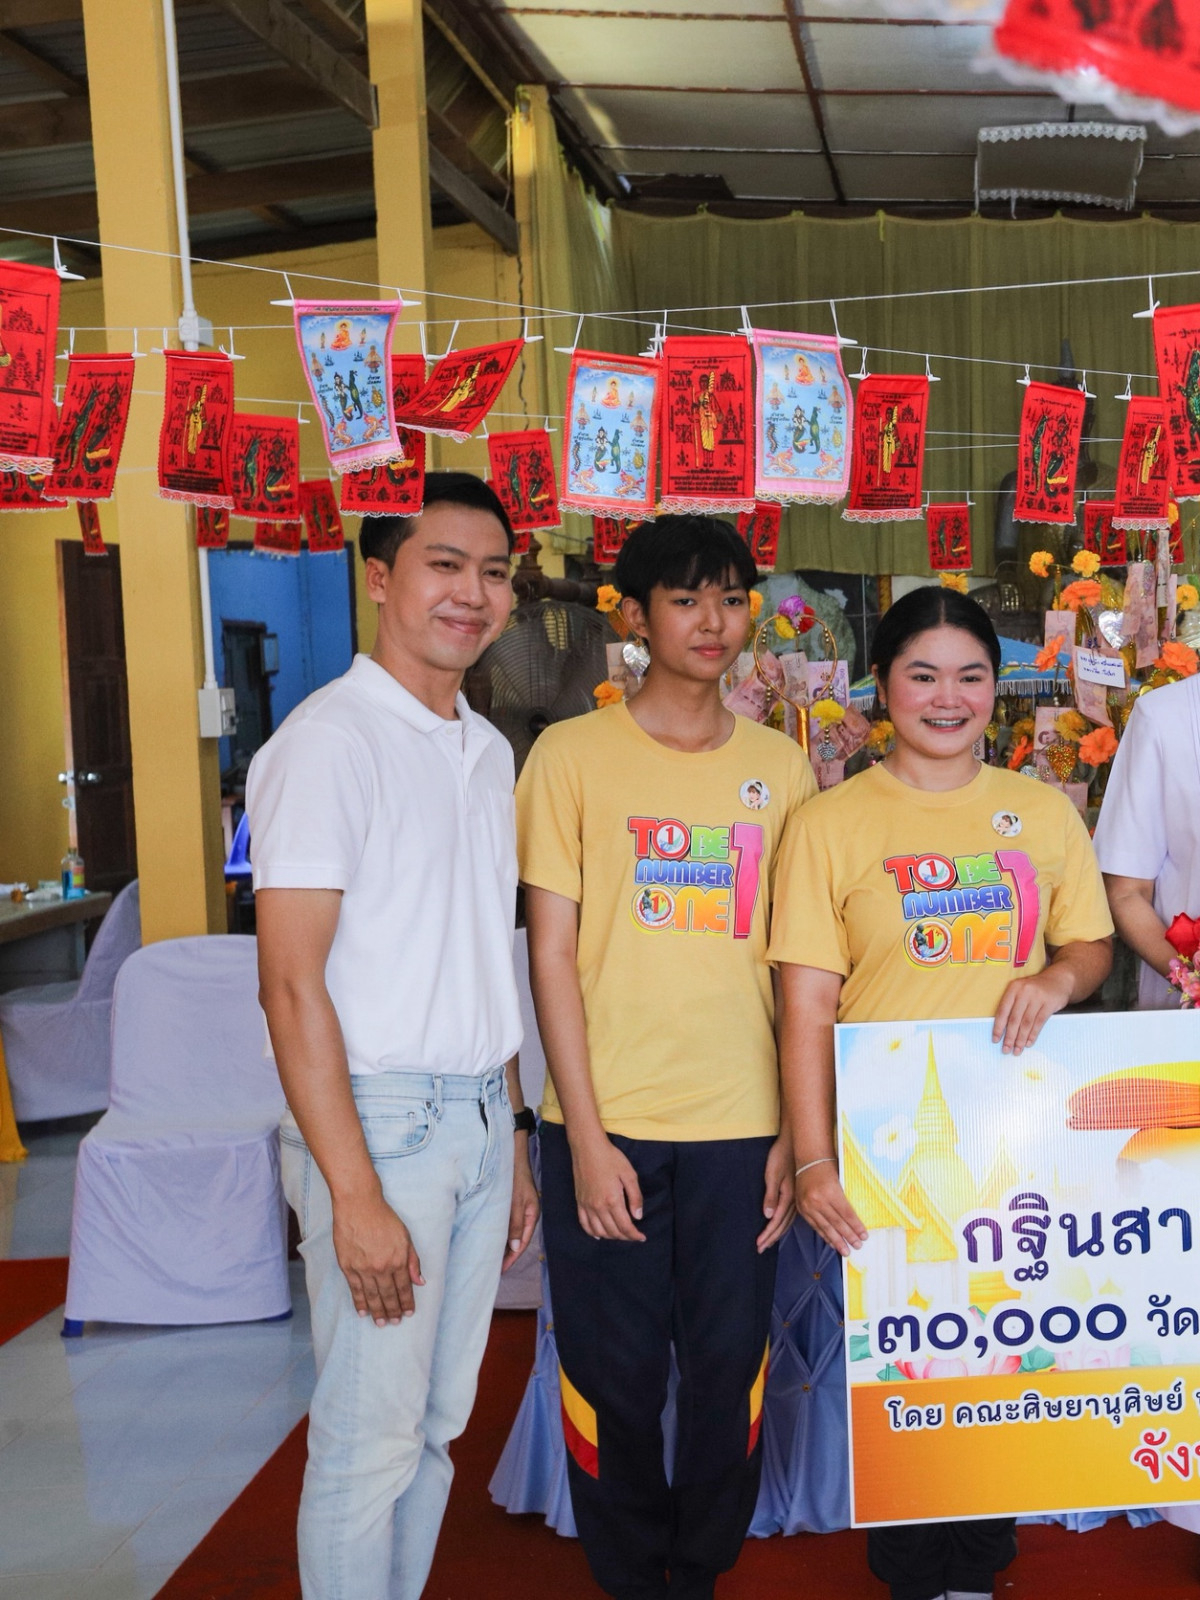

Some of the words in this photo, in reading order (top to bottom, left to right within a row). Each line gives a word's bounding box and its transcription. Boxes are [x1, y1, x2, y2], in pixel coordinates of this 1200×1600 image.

[628, 816, 690, 860] TO
[690, 825, 730, 859] BE
[636, 858, 734, 887] NUMBER
[884, 853, 957, 894] TO
[953, 853, 1002, 886] BE
[631, 884, 731, 933] ONE
[902, 884, 1014, 919] NUMBER
[904, 911, 1012, 967] ONE
[877, 1302, 1128, 1360] ๓๐,๐๐๐
[1146, 1294, 1200, 1338] วัด
[886, 1396, 943, 1430] โดย
[955, 1381, 1184, 1426] คณะศิษยานุศิษย์
